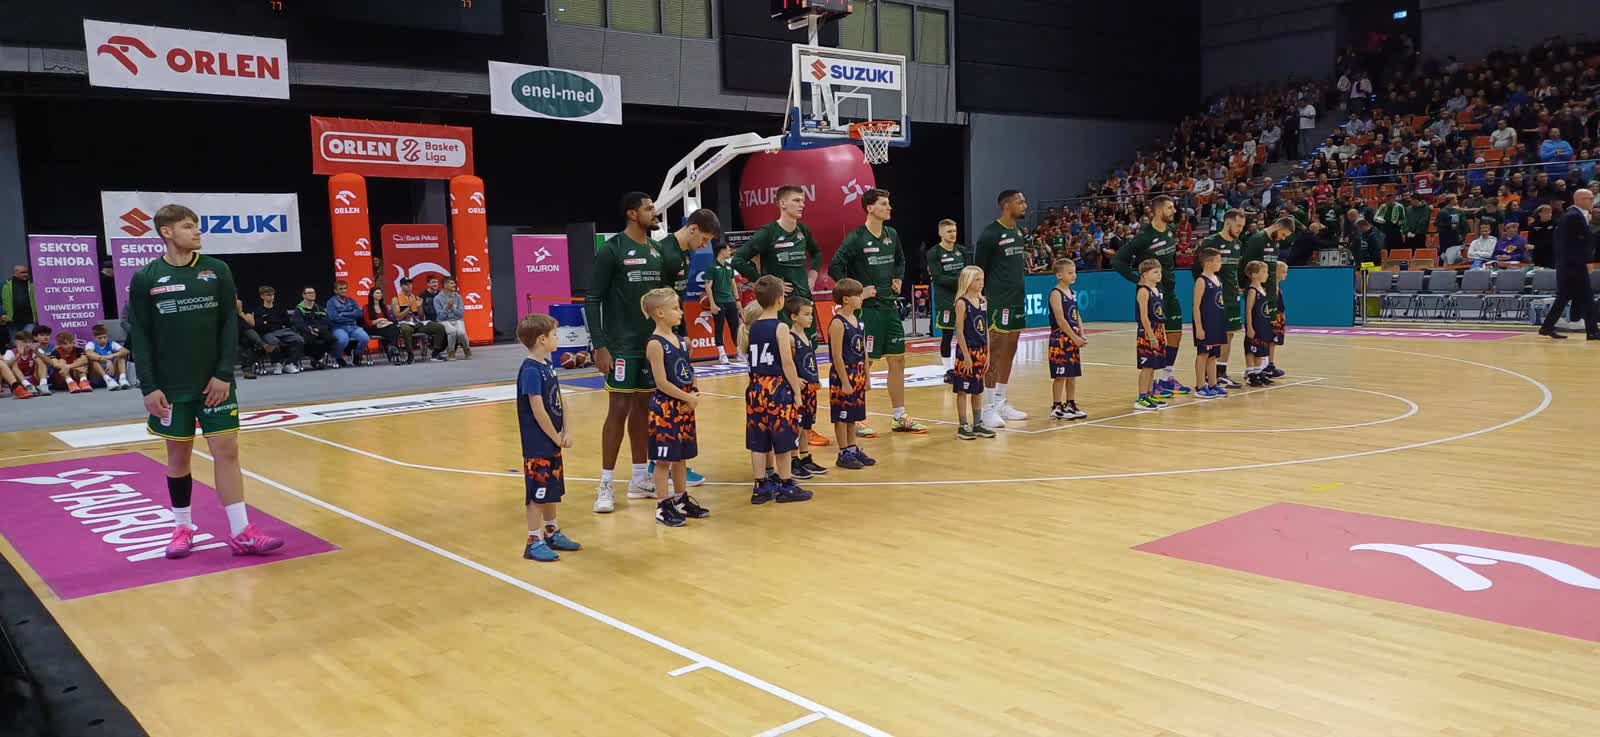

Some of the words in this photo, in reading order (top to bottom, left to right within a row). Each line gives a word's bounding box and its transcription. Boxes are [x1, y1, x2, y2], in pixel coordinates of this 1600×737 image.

[166, 47, 280, 80] ORLEN
[830, 65, 893, 84] SUZUKI
[521, 83, 594, 103] enel-med
[328, 139, 392, 157] ORLEN
[425, 141, 458, 152] Basket
[425, 152, 447, 163] Liga
[744, 184, 816, 208] TAURN
[200, 214, 288, 234] ZUKI
[40, 243, 89, 253] SEKTOR
[38, 256, 94, 267] SENIORA
[526, 264, 560, 273] TAURON
[44, 302, 100, 311] UNIWERSYTET
[1025, 293, 1047, 315] IE,
[51, 312, 95, 320] TRZECIEGO
[1071, 308, 1078, 320] 4
[1156, 305, 1163, 316] 4
[976, 319, 985, 332] 4
[691, 337, 716, 348] ORLE
[855, 338, 863, 351] 4
[750, 342, 774, 367] 14
[808, 357, 816, 369] 4
[1140, 357, 1148, 365] 7
[680, 367, 689, 379] 4
[657, 446, 669, 457] 11
[535, 487, 547, 499] 8
[48, 483, 229, 562] TAURON
